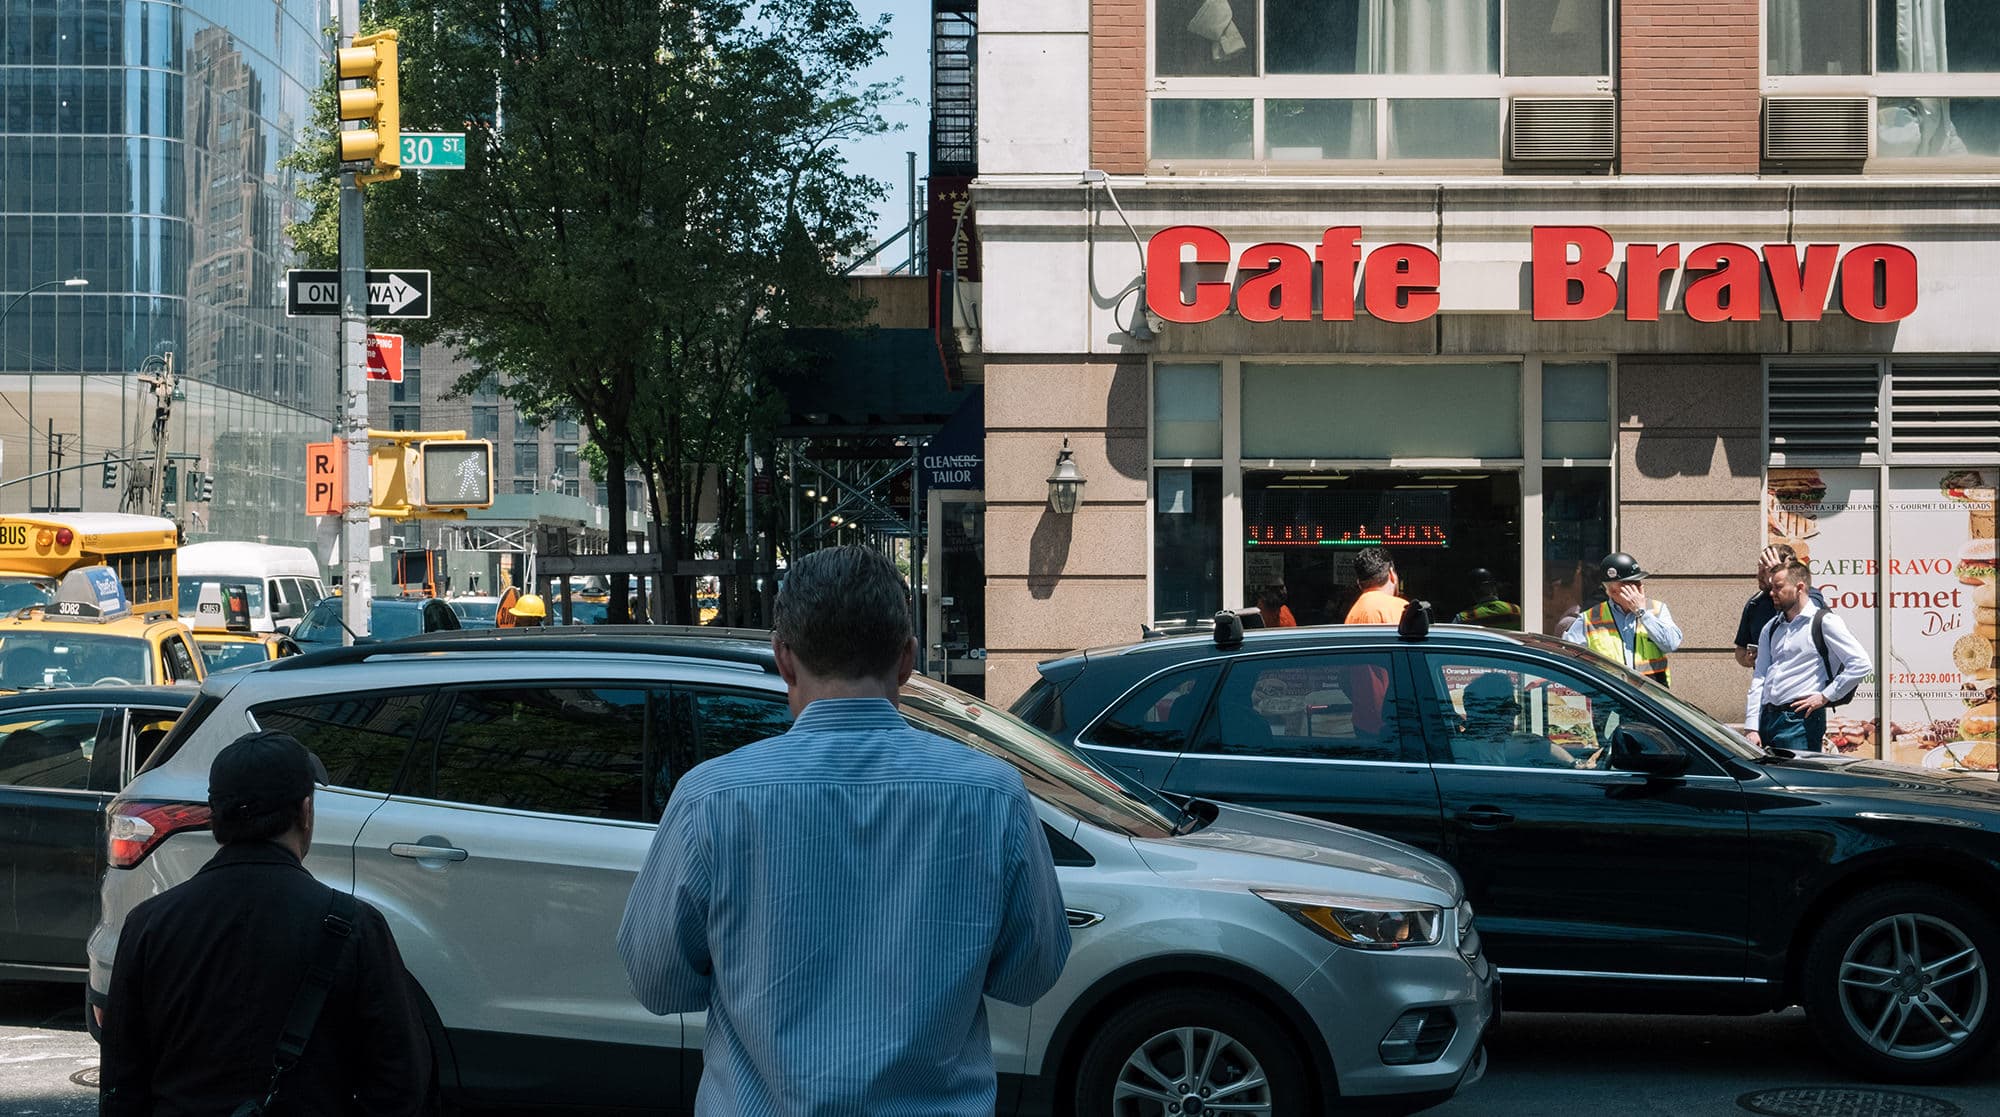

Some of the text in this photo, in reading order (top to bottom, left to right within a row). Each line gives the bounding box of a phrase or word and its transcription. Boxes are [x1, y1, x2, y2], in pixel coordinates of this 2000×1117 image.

[402, 138, 433, 165] 30
[1146, 225, 1918, 323] Cafe Bravo
[308, 285, 408, 302] ON WAY
[923, 455, 977, 469] CLEANERS
[932, 470, 972, 483] TAILOR
[1811, 503, 1826, 511] TEA
[1832, 503, 1856, 511] FRESH
[0, 526, 26, 544] BUS
[1818, 584, 1962, 609] Gourmet
[1921, 611, 1961, 637] Deli
[1899, 673, 1962, 684] 212.239.0011
[1909, 690, 1953, 699] SMOOTHIES
[1959, 690, 1985, 699] HEROS
